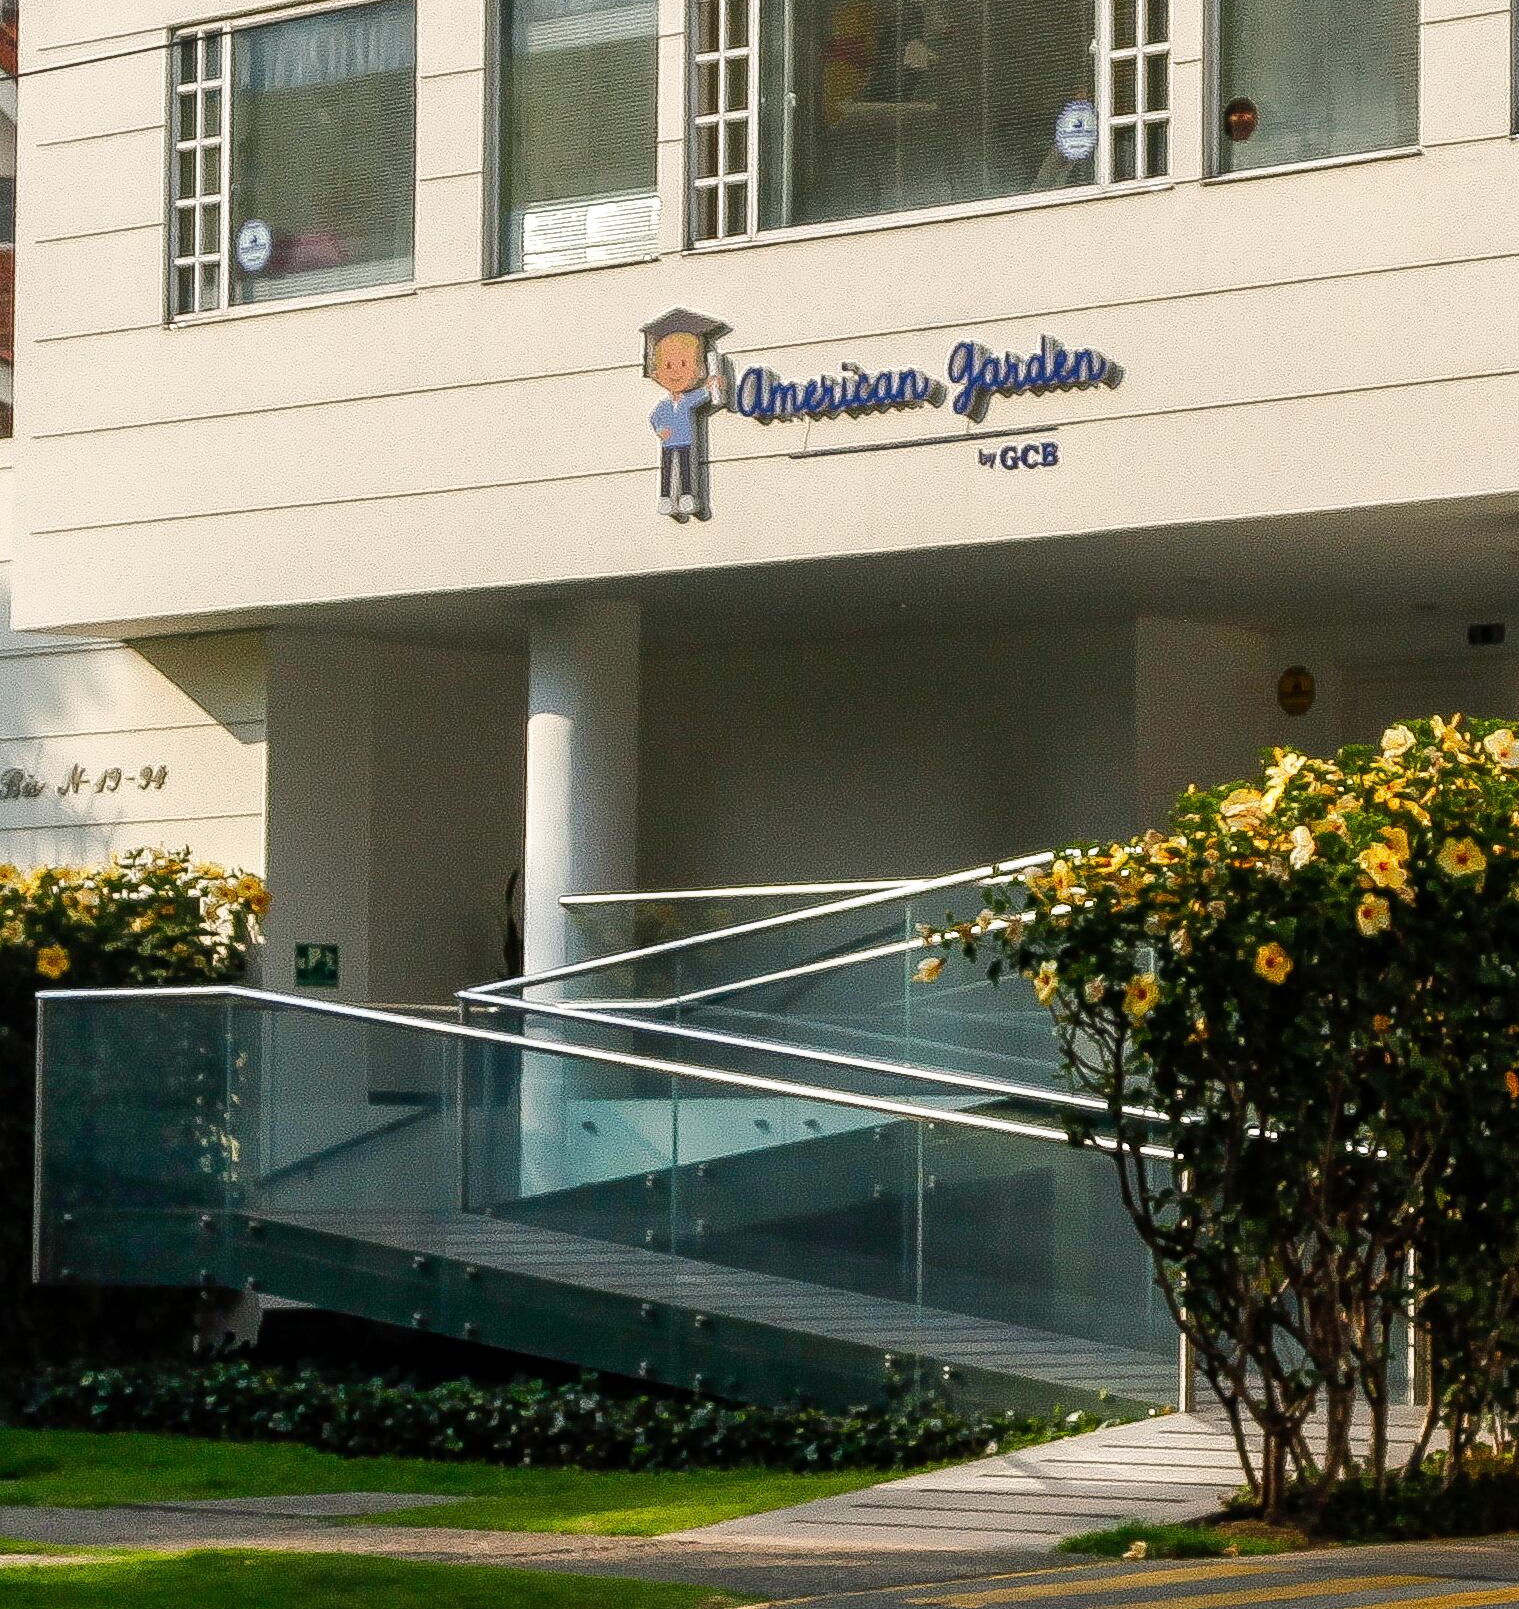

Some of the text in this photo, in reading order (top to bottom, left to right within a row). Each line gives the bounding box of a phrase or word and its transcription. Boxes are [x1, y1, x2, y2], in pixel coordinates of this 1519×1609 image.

[736, 362, 935, 418] American
[979, 443, 1058, 469] by GCB
